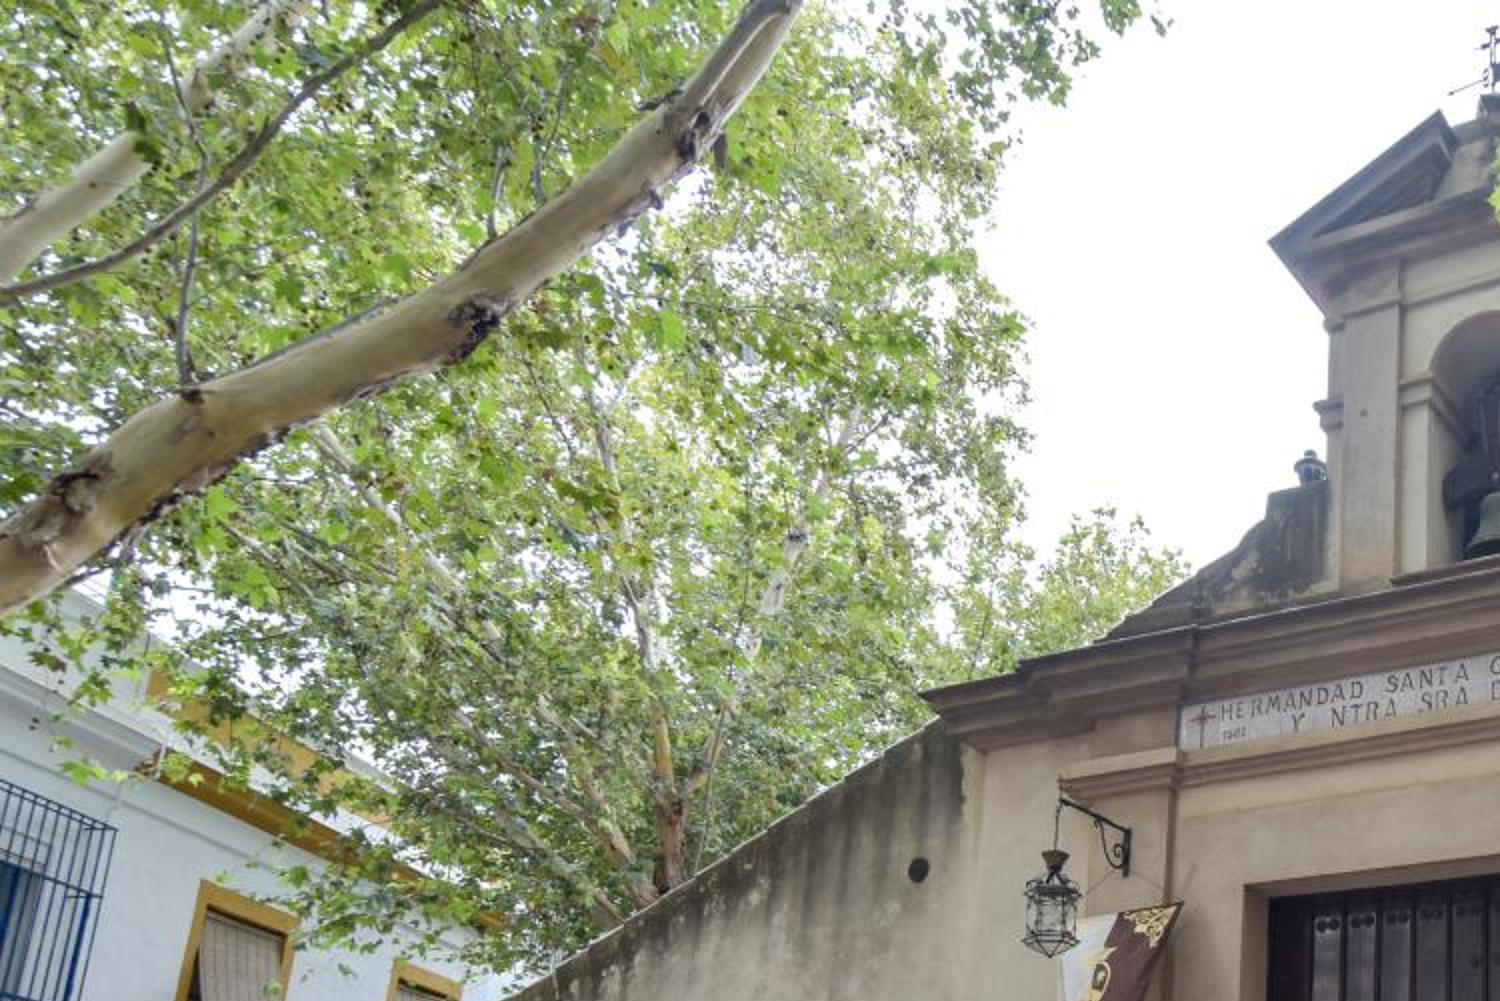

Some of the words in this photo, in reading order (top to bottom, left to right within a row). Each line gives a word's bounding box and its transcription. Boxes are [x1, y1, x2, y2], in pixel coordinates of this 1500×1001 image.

[1220, 681, 1364, 721] HERMANDAD
[1384, 662, 1470, 694] SANTA
[1291, 712, 1306, 733] Y
[1331, 697, 1397, 728] NTRA
[1418, 686, 1470, 712] SRA
